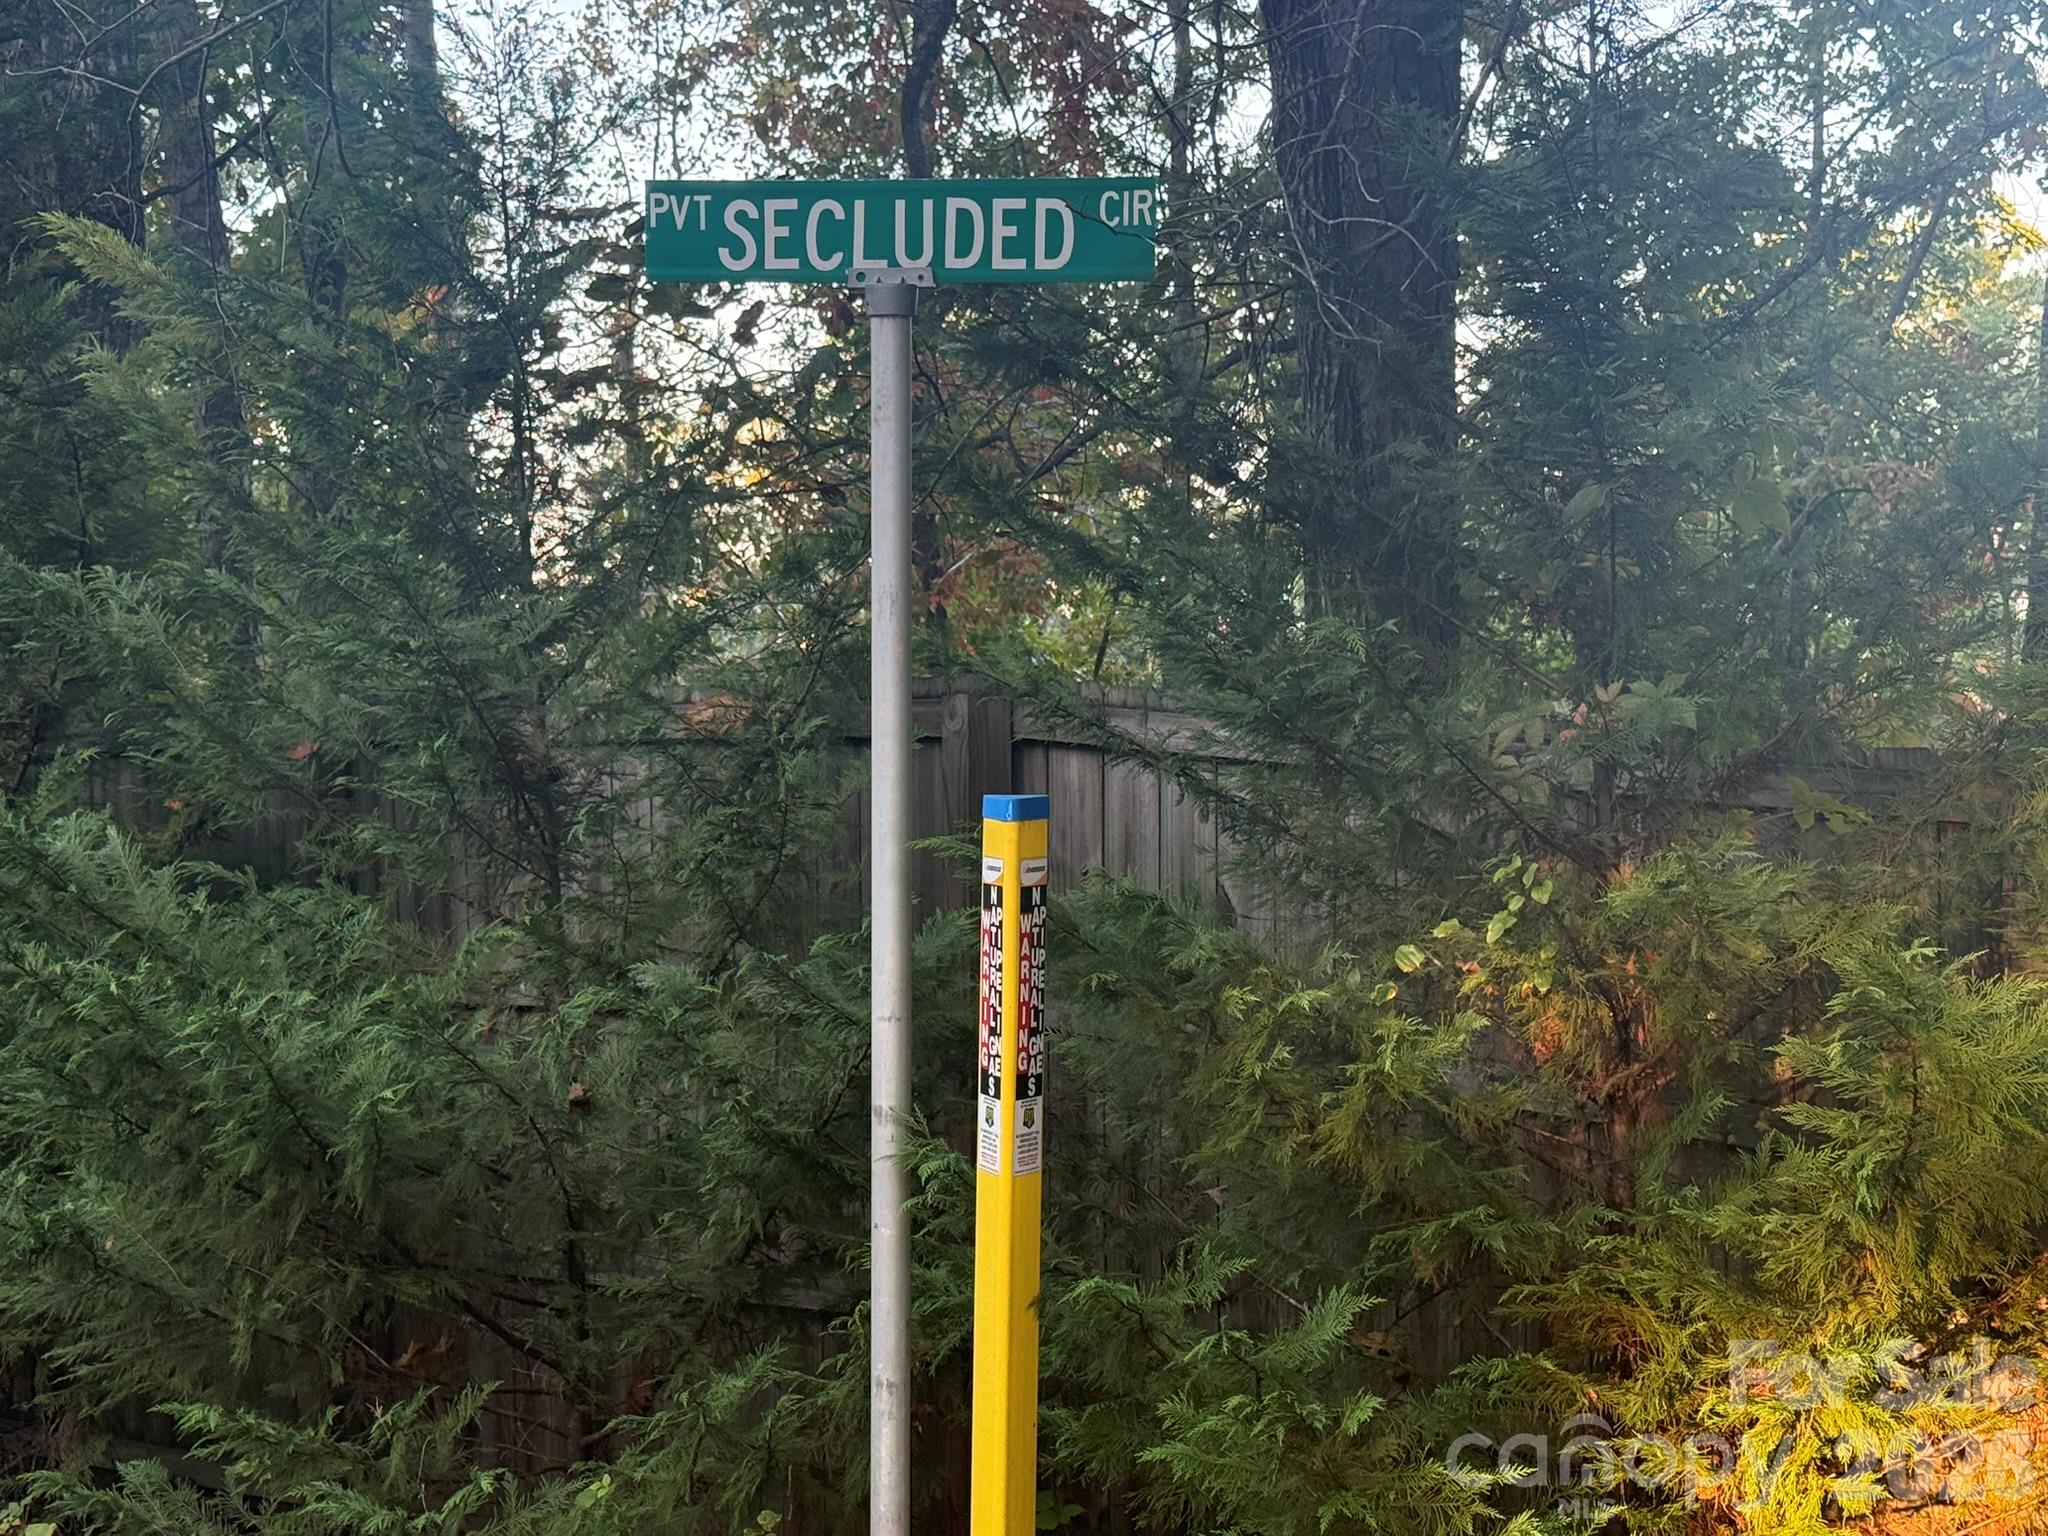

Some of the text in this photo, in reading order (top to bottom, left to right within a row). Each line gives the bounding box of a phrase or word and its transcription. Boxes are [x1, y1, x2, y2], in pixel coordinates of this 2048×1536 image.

[649, 190, 1153, 272] PVT SECLUDED CIR
[981, 909, 991, 1068] WARNING
[989, 885, 998, 1028] NATURAL
[994, 906, 1003, 1078] PIPELINE
[1018, 914, 1032, 1072] WARNING
[1030, 886, 1041, 1028] NATURAL
[1036, 906, 1047, 1074] PIPELINE
[988, 1035, 997, 1096] GAS
[1027, 1036, 1037, 1097] GAS
